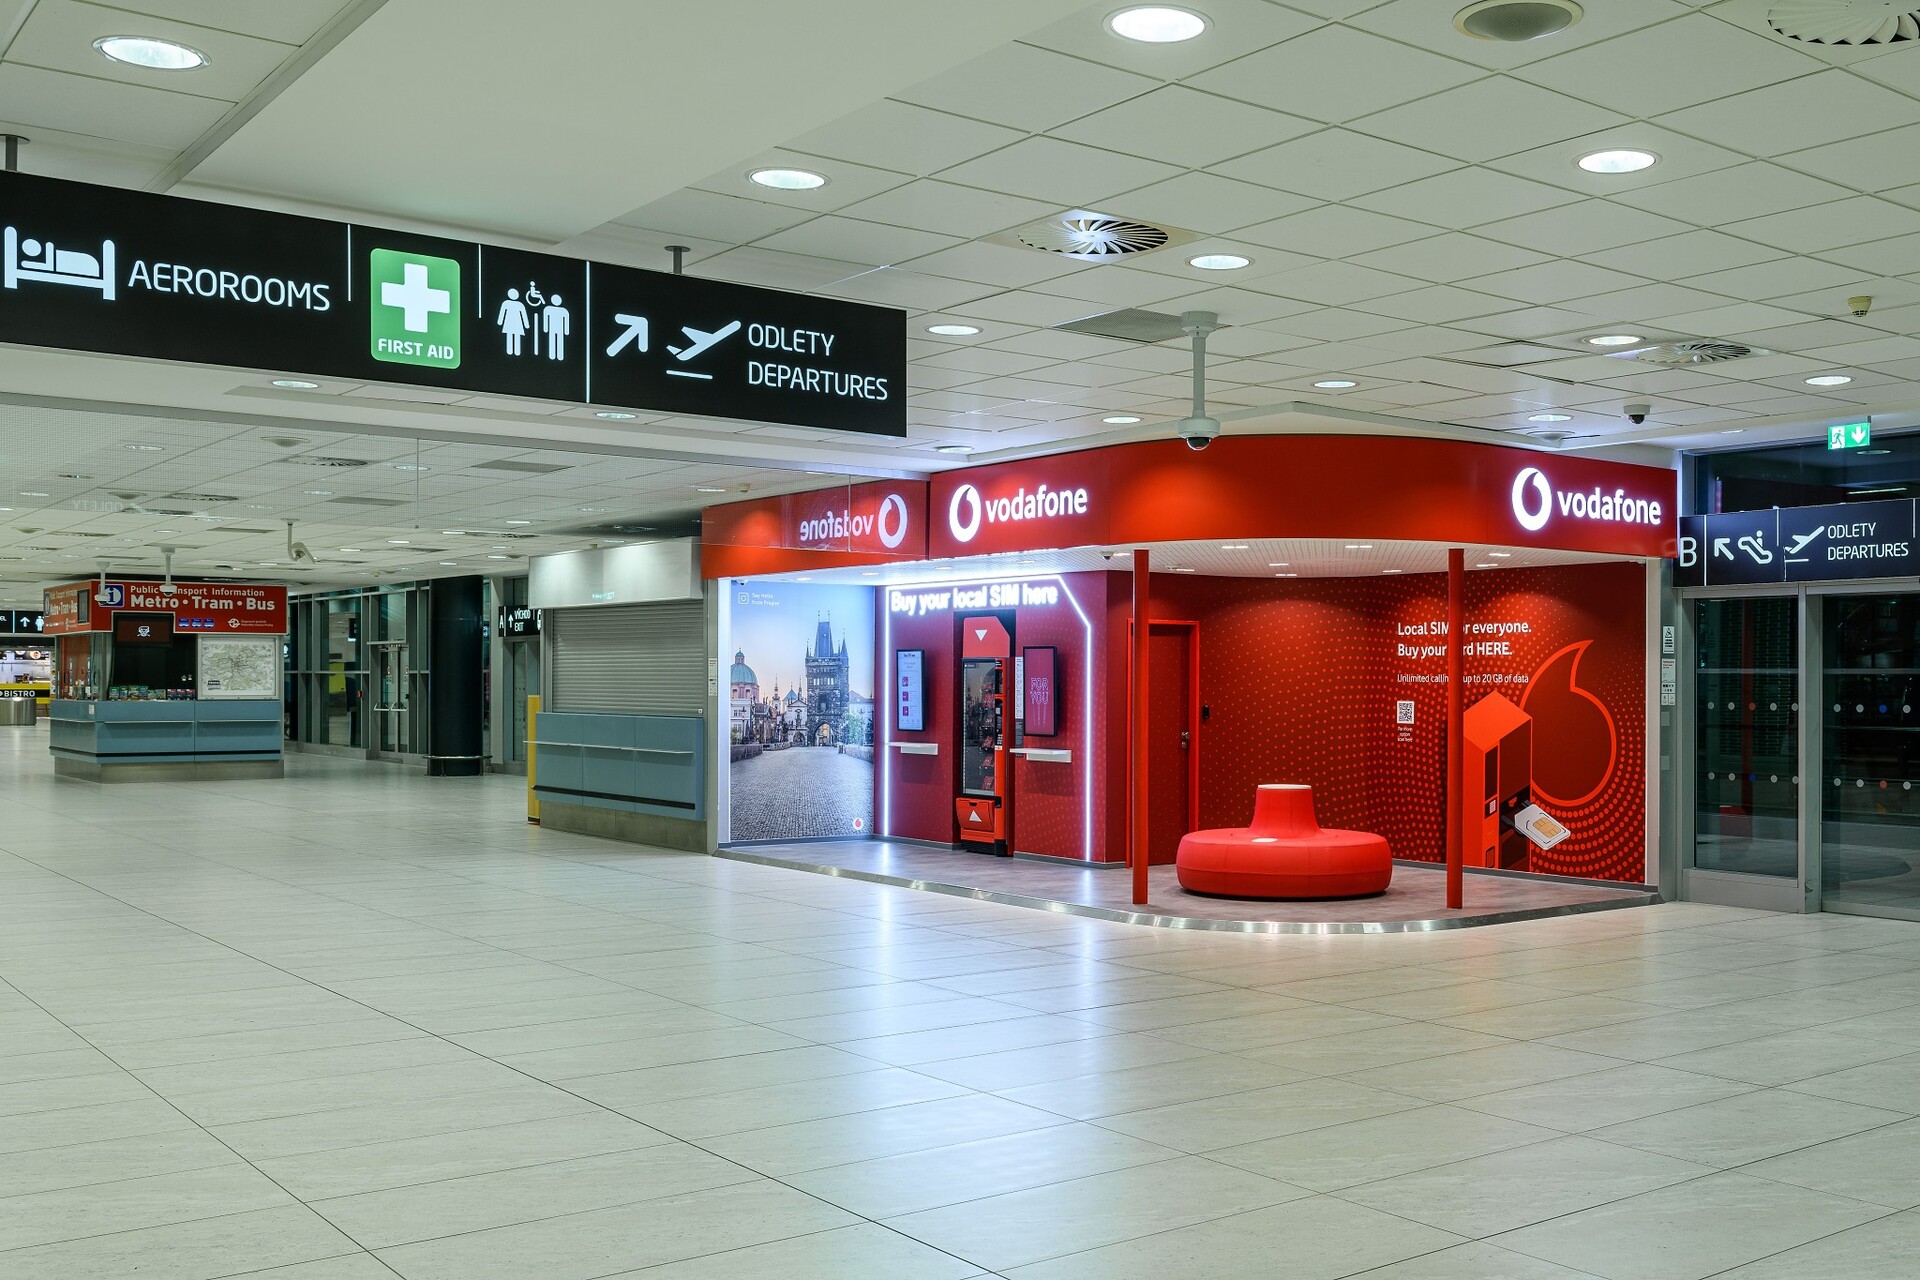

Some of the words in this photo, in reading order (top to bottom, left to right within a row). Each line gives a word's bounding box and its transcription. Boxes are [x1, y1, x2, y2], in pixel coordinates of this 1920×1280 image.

[128, 259, 331, 312] AEROROOMS
[378, 338, 423, 357] FIRST
[427, 343, 454, 361] AID
[747, 323, 835, 357] ODLETY
[747, 361, 889, 401] DEPARTURES
[985, 484, 1088, 523] vodafone
[1557, 487, 1661, 525] vodafone
[1827, 522, 1877, 539] ODLETY
[1679, 536, 1698, 568] B
[1827, 542, 1909, 561] DEPARTURES
[130, 586, 159, 594] Public
[212, 588, 265, 597] Information
[891, 590, 917, 616] Buy
[918, 592, 950, 616] your
[952, 586, 987, 609] local
[989, 583, 1019, 607] SIM
[1022, 581, 1059, 605] here
[130, 594, 179, 608] Metro
[191, 596, 233, 609] Tram
[246, 597, 275, 611] Bus
[1398, 622, 1428, 636] Local
[1472, 622, 1532, 637] everyone.
[1398, 643, 1419, 659] Buy
[1421, 645, 1447, 659] your
[1476, 642, 1513, 656] HERE.
[1397, 673, 1429, 683] Unlimited
[1473, 674, 1481, 683] to
[1482, 673, 1492, 683] 20
[1493, 673, 1503, 683] GB
[1504, 673, 1513, 683] of
[1513, 673, 1529, 683] data
[4, 690, 36, 698] BISTRO
